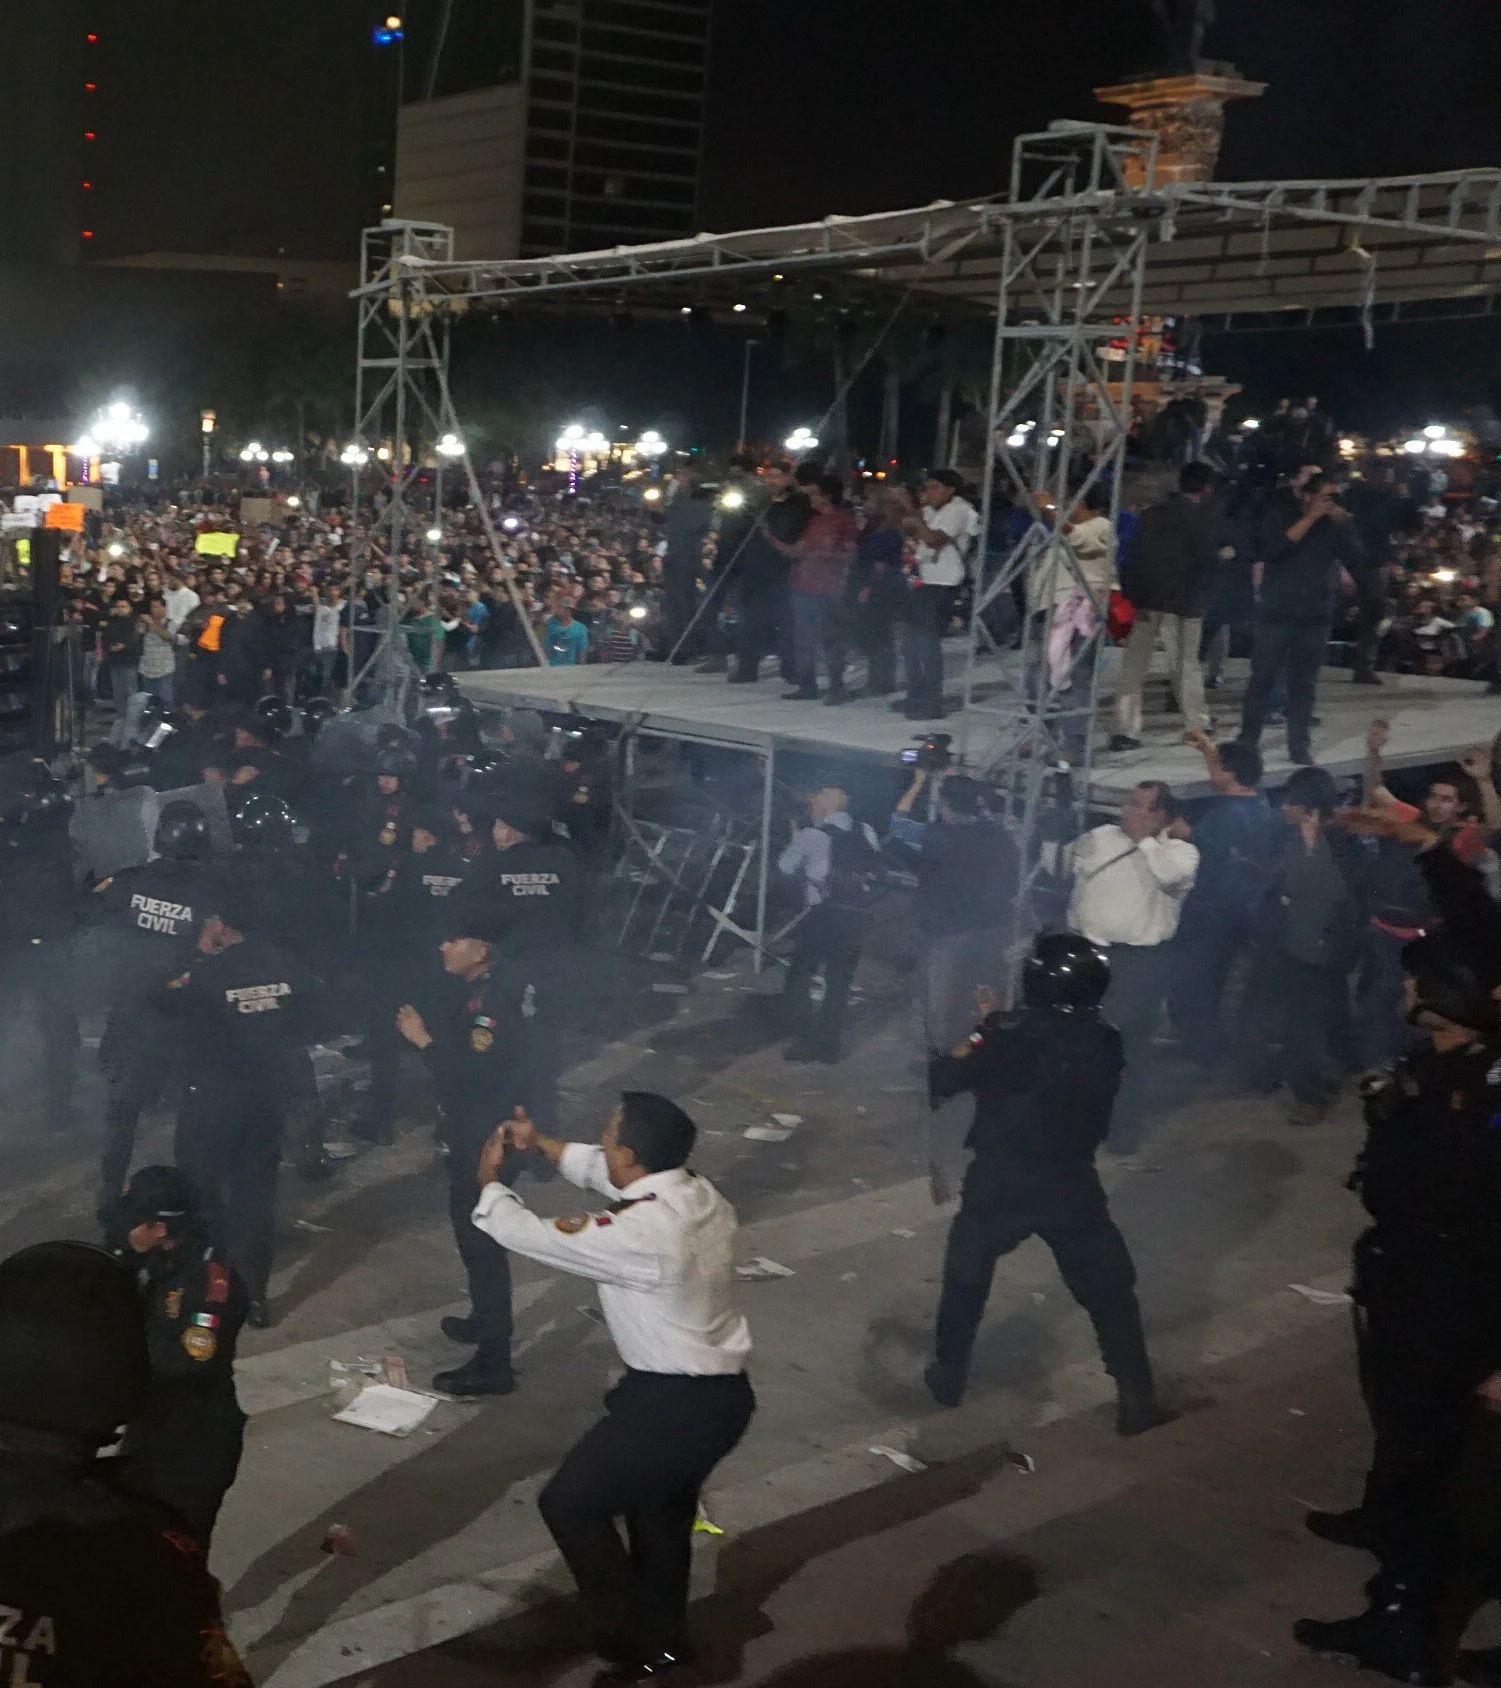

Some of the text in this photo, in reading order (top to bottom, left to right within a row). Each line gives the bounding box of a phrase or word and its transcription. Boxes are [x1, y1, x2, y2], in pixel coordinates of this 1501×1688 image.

[501, 873, 560, 885] FUERZA
[130, 893, 193, 922] FUERZA
[137, 912, 178, 935] CIVIL
[225, 982, 292, 1002] FUERZA
